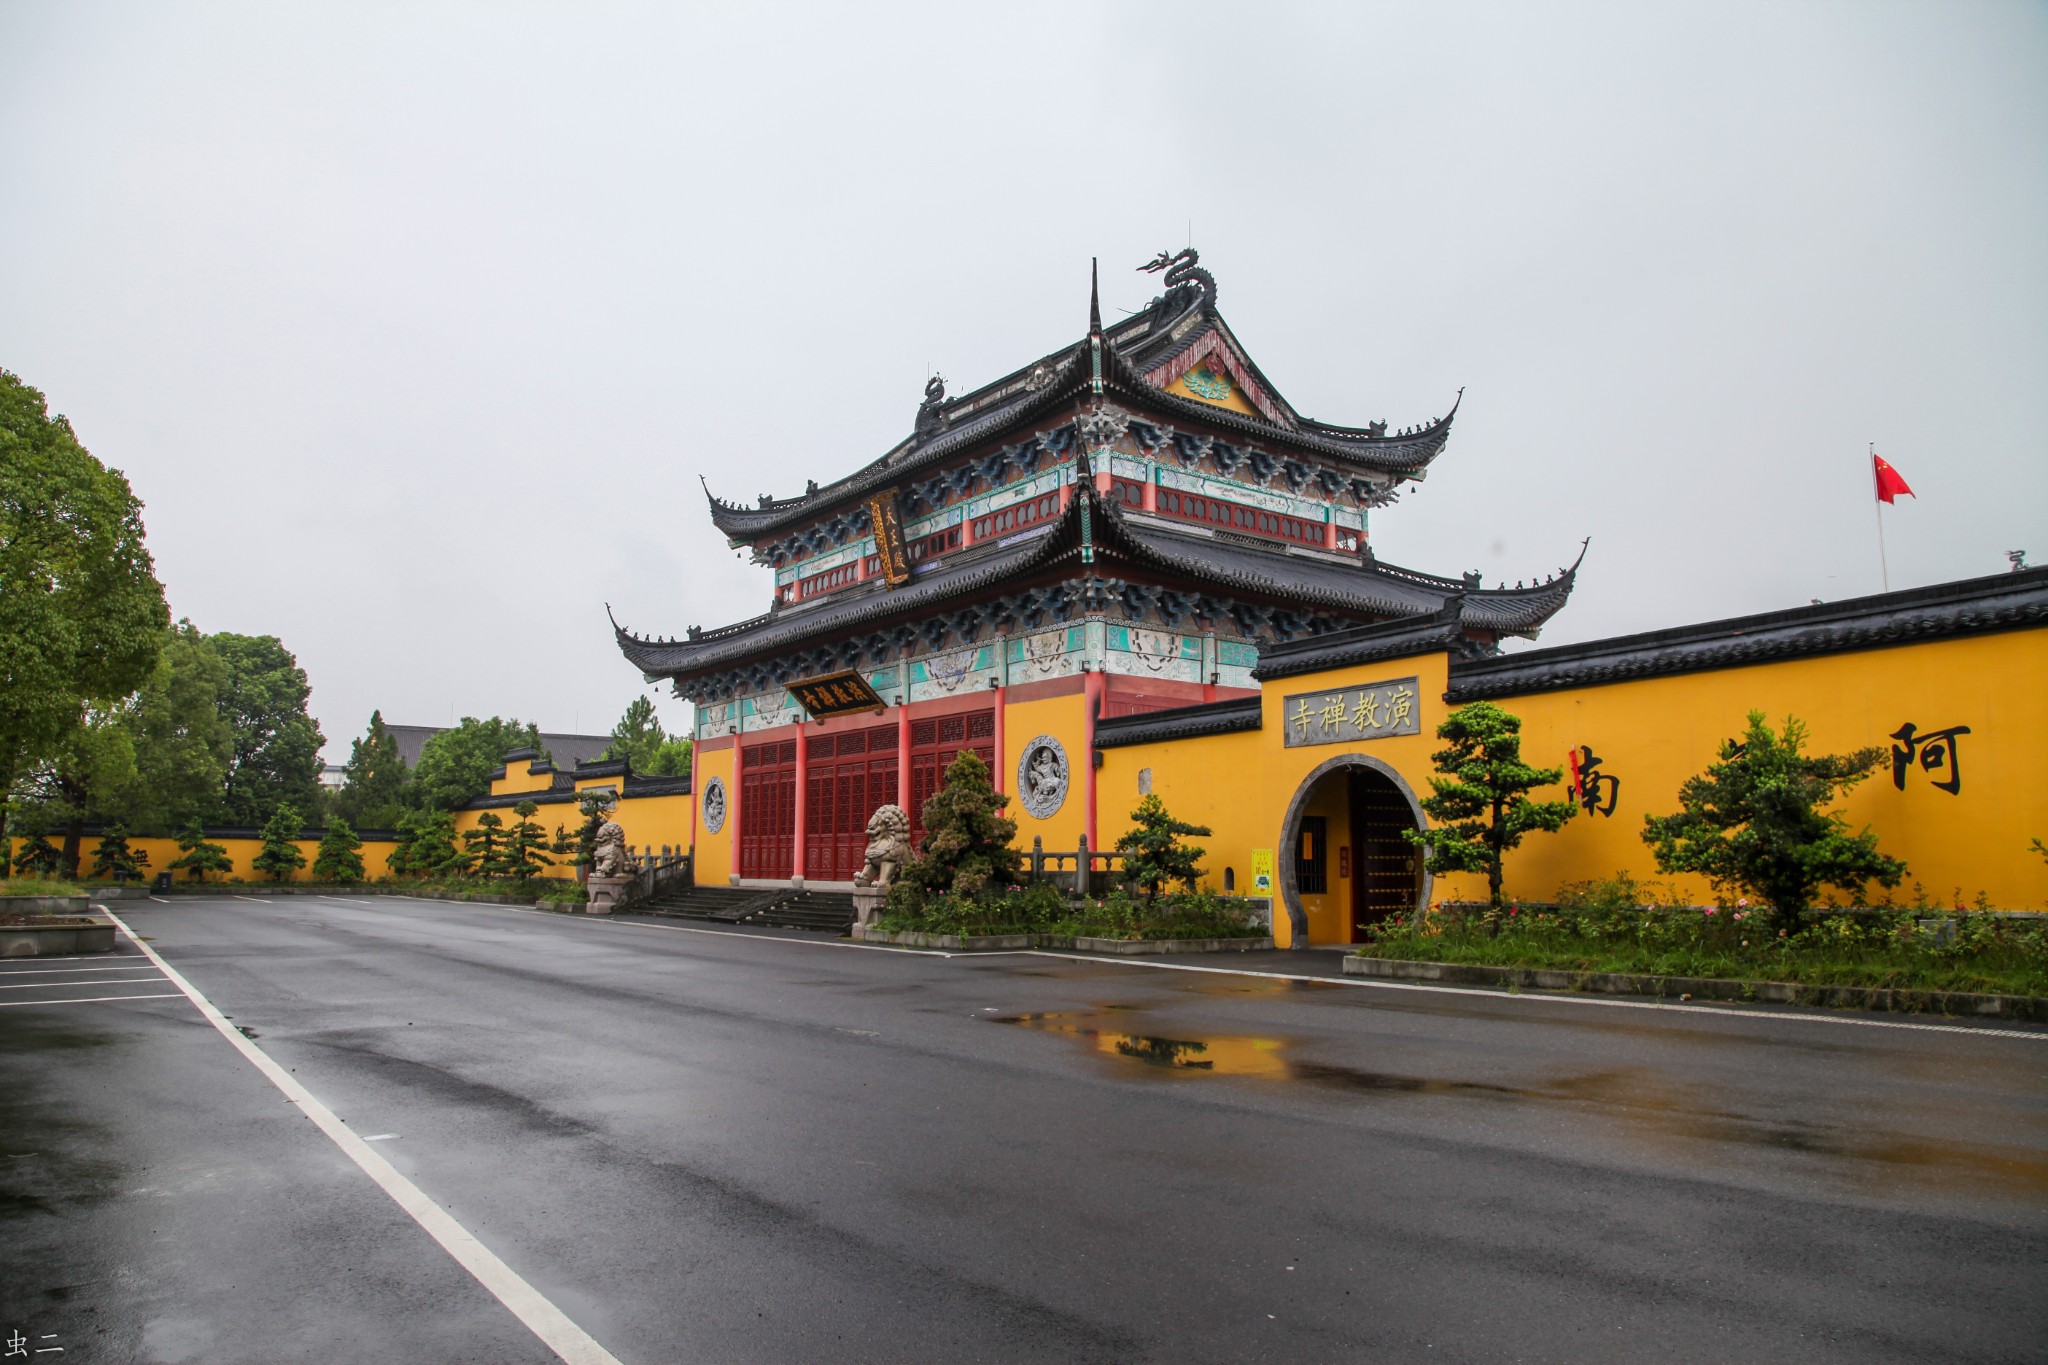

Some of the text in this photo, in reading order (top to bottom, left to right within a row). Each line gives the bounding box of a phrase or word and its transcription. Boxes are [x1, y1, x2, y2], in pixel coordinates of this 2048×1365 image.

[886, 506, 906, 568] 天王殿
[1889, 722, 1971, 796] 阿
